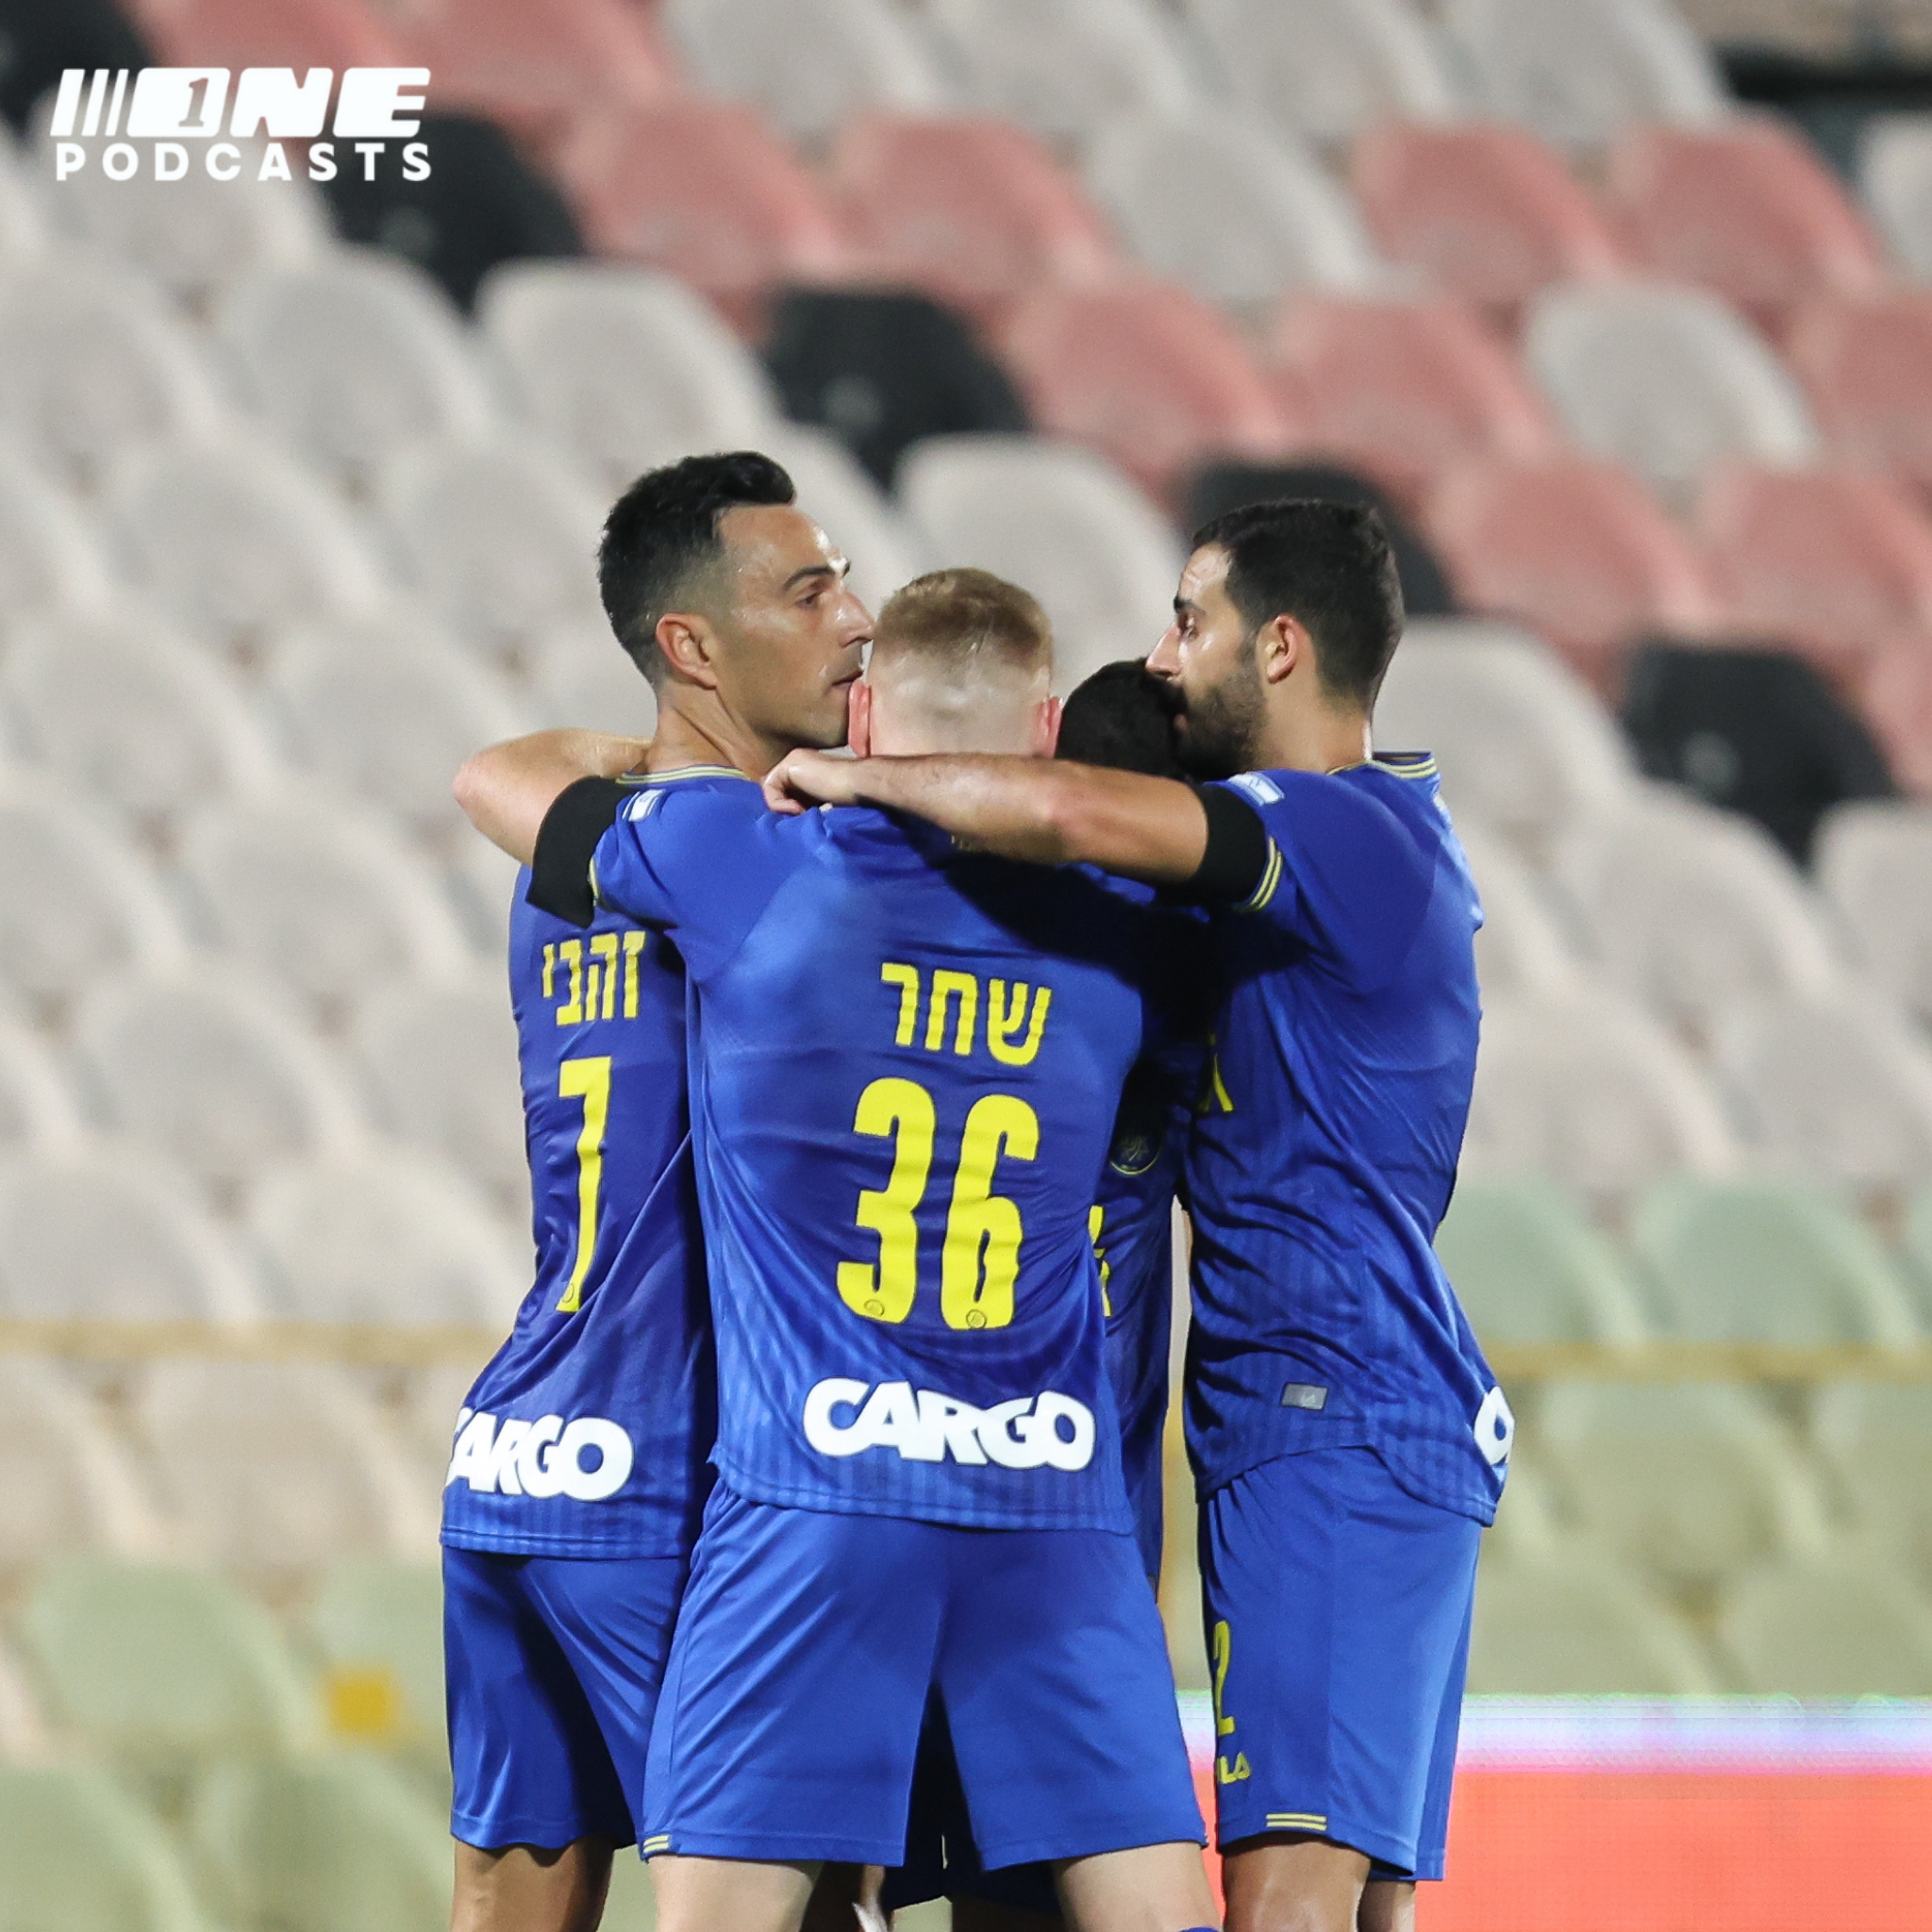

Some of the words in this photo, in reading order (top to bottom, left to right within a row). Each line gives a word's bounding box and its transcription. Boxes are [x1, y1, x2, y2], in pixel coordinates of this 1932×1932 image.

[541, 930, 647, 1025] זהבי
[881, 962, 1052, 1066] שחר
[556, 1056, 612, 1313] 7
[836, 1076, 1041, 1331] 36
[445, 1407, 635, 1502] ARGO
[802, 1377, 1096, 1472] CARGO
